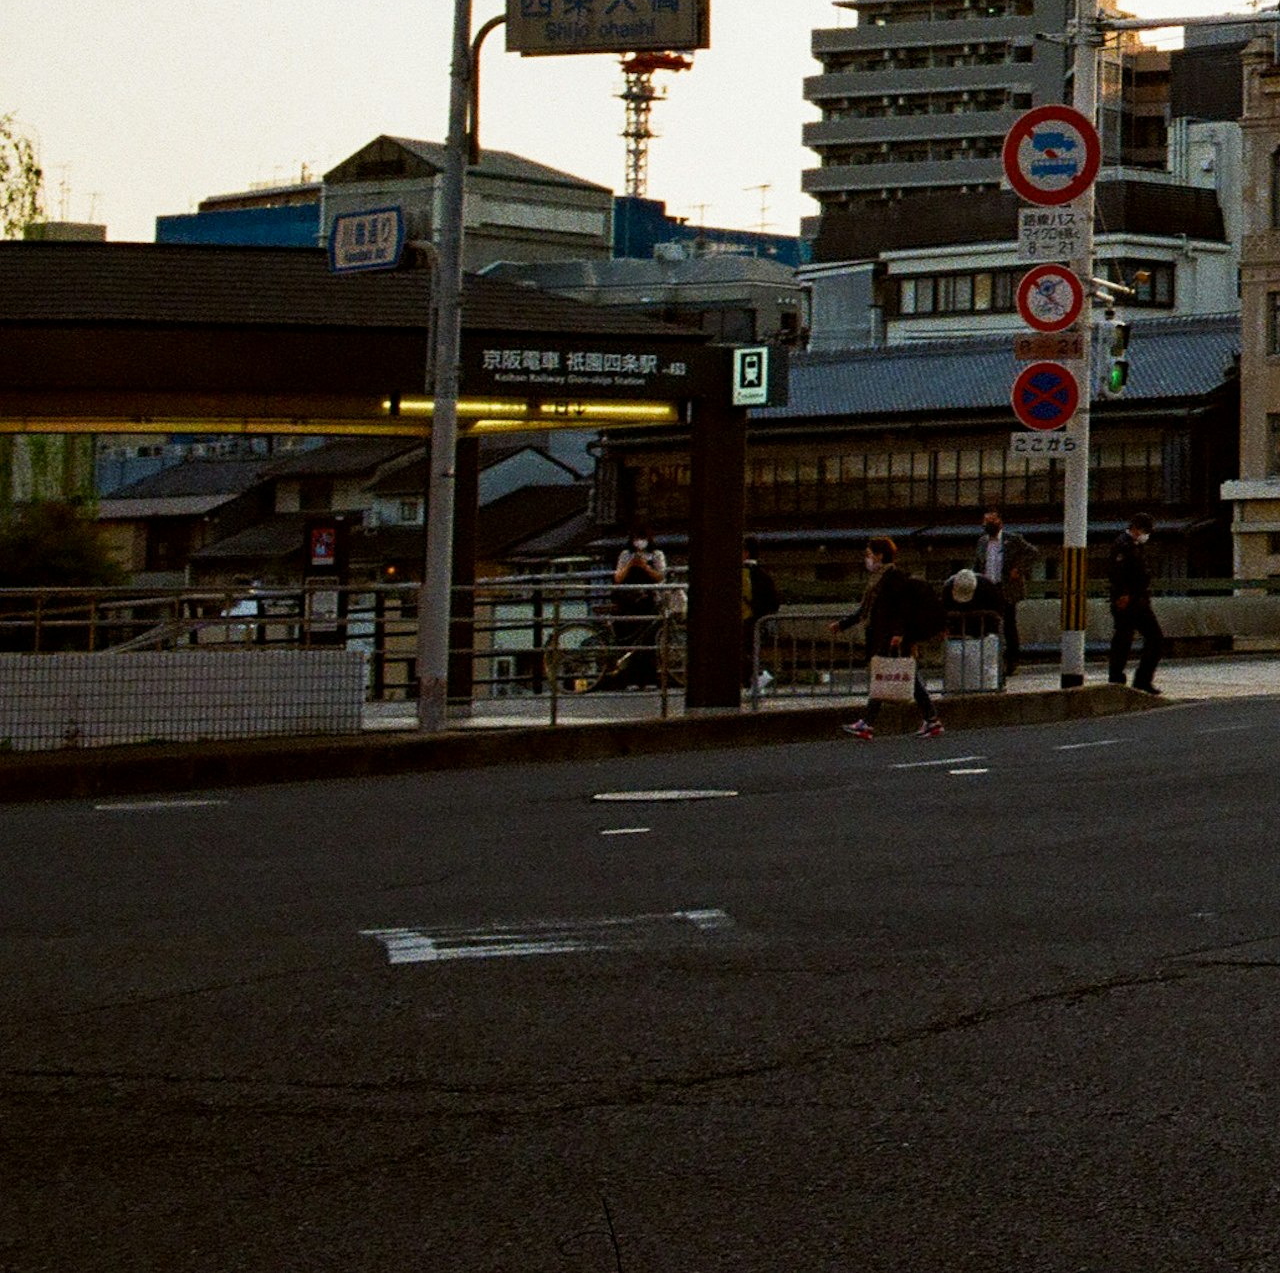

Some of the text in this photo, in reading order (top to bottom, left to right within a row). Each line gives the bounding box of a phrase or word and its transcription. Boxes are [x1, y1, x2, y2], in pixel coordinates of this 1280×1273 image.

[482, 349, 560, 371] 京阪電車
[566, 352, 658, 374] 祇園四条駅
[1015, 438, 1076, 452] ここから
